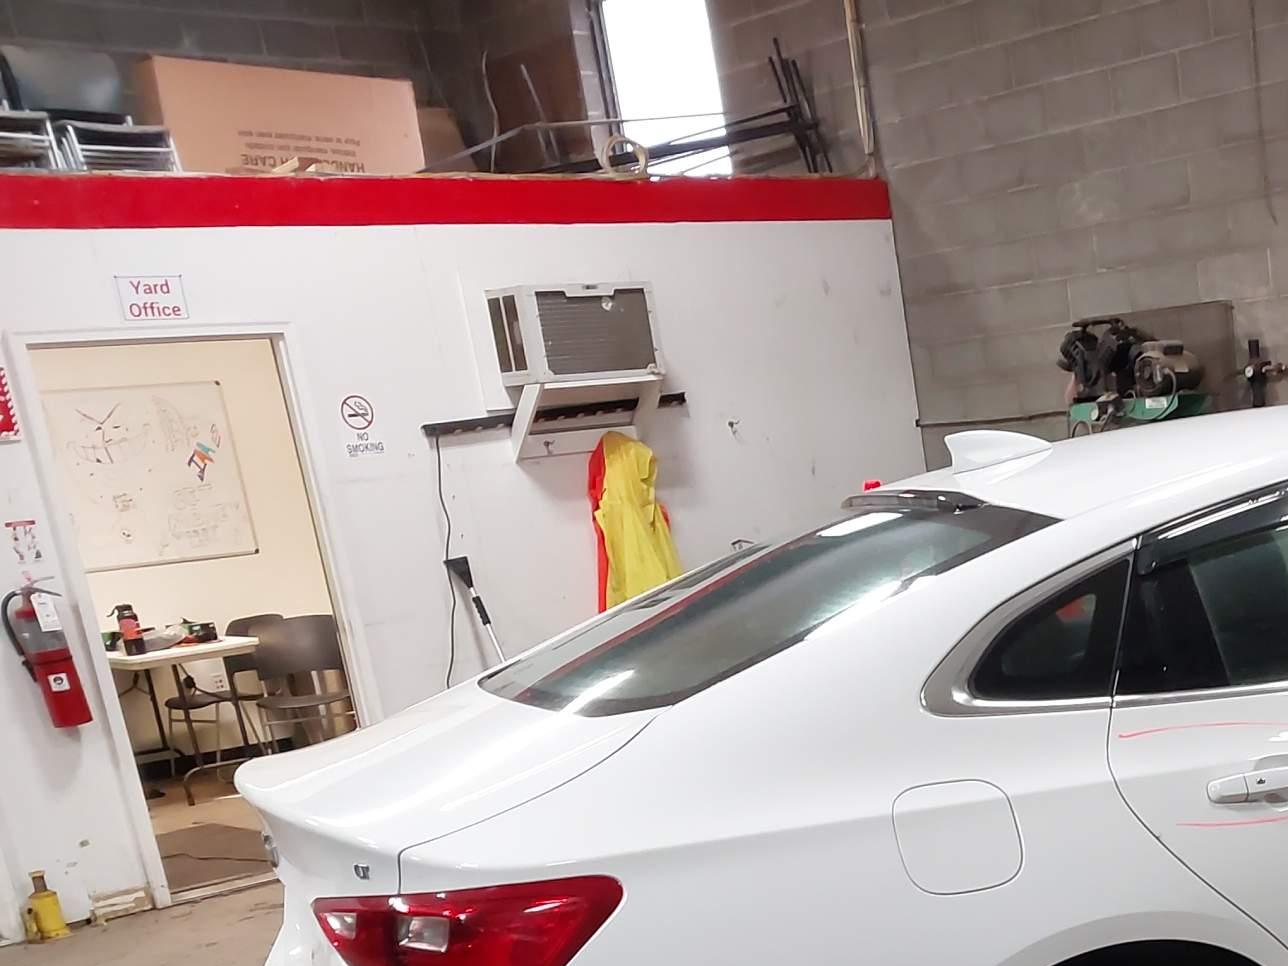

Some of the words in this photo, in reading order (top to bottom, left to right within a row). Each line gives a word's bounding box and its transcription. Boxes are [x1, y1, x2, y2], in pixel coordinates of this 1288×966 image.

[240, 153, 276, 169] CARE
[129, 279, 170, 295] Yard
[129, 301, 182, 318] Office
[357, 432, 369, 441] NO
[346, 442, 384, 454] SMOKING
